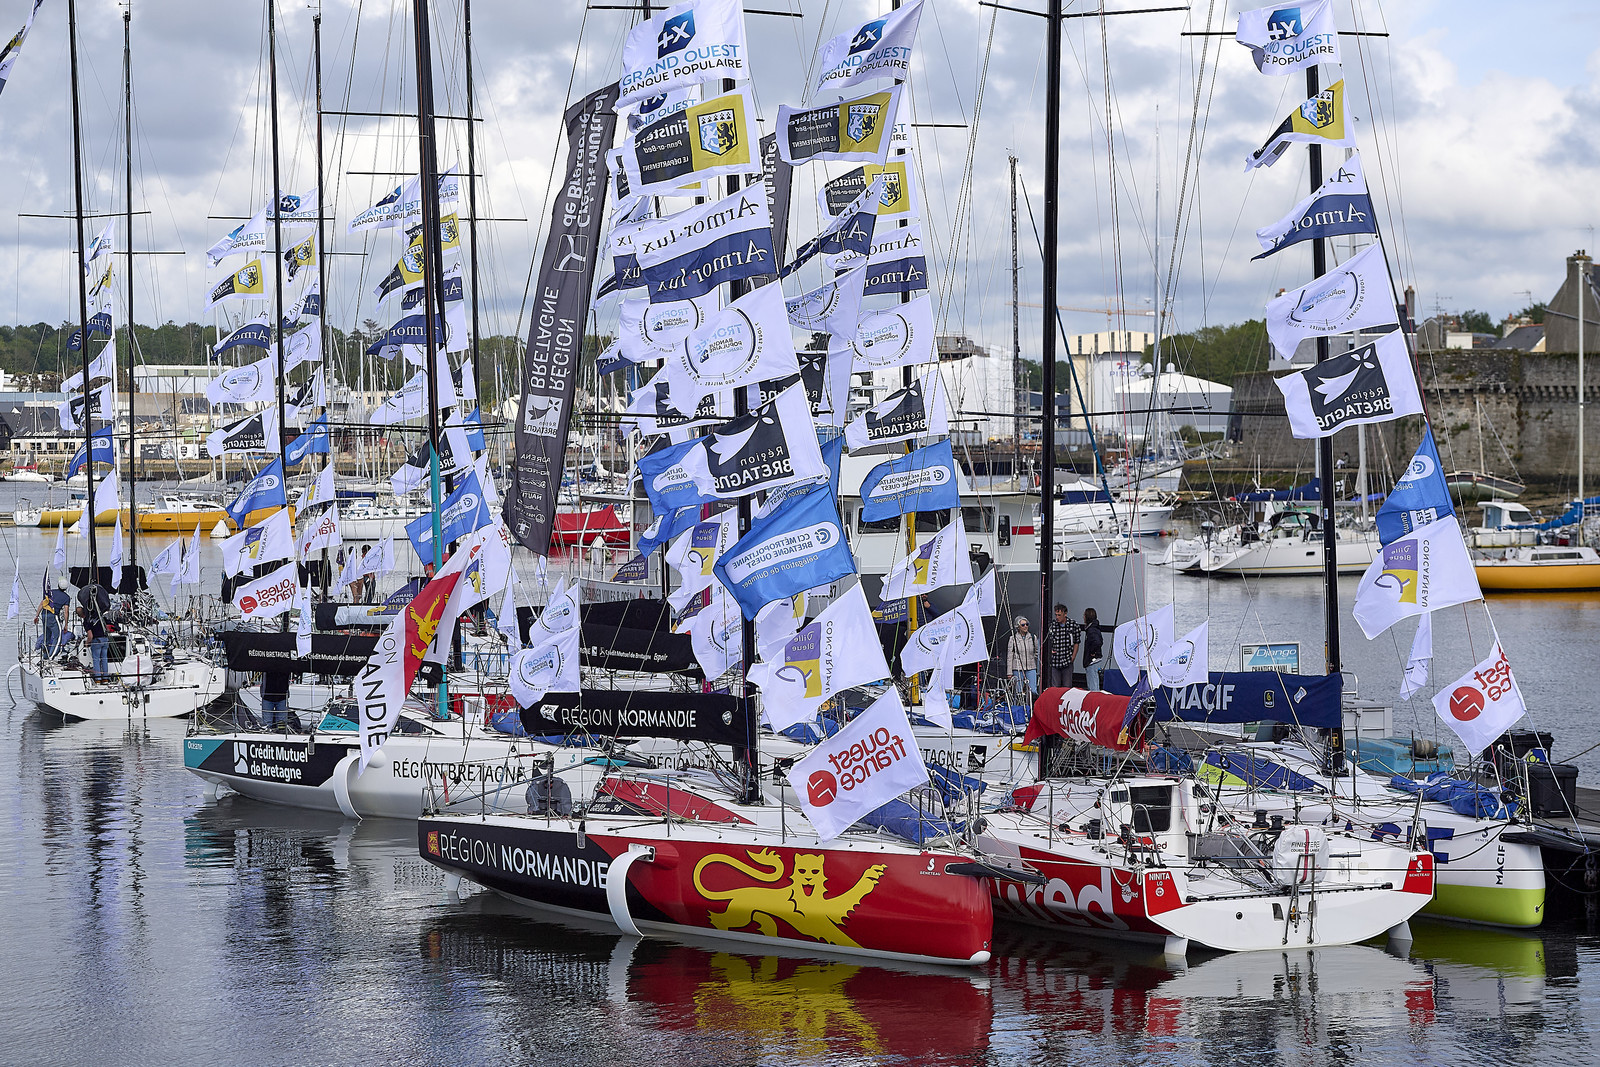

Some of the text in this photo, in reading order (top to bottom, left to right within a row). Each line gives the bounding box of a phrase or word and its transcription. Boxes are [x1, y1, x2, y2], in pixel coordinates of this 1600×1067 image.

[866, 46, 911, 62] OUEST
[1282, 32, 1334, 56] OUEST
[622, 44, 740, 87] GRAND OUEST
[1272, 45, 1334, 66] POPULAIRE
[622, 58, 742, 97] BANQUE POPULAIRE
[855, 59, 908, 76] POPULAIRE
[386, 209, 421, 221] POPULAIRE
[393, 200, 421, 213] OUEST
[236, 232, 265, 243] OUEST
[1256, 648, 1297, 658] Django
[1171, 684, 1236, 710] MACIF
[561, 706, 697, 728] RÉGION NORMANDIE
[249, 743, 308, 763] Crédit Mutuel
[250, 761, 302, 782] de Bretagne
[393, 757, 444, 780] RÉGION
[440, 829, 609, 890] RÉGION NORMANDIE
[1495, 845, 1506, 885] MACIF
[1148, 872, 1170, 881] NINITA
